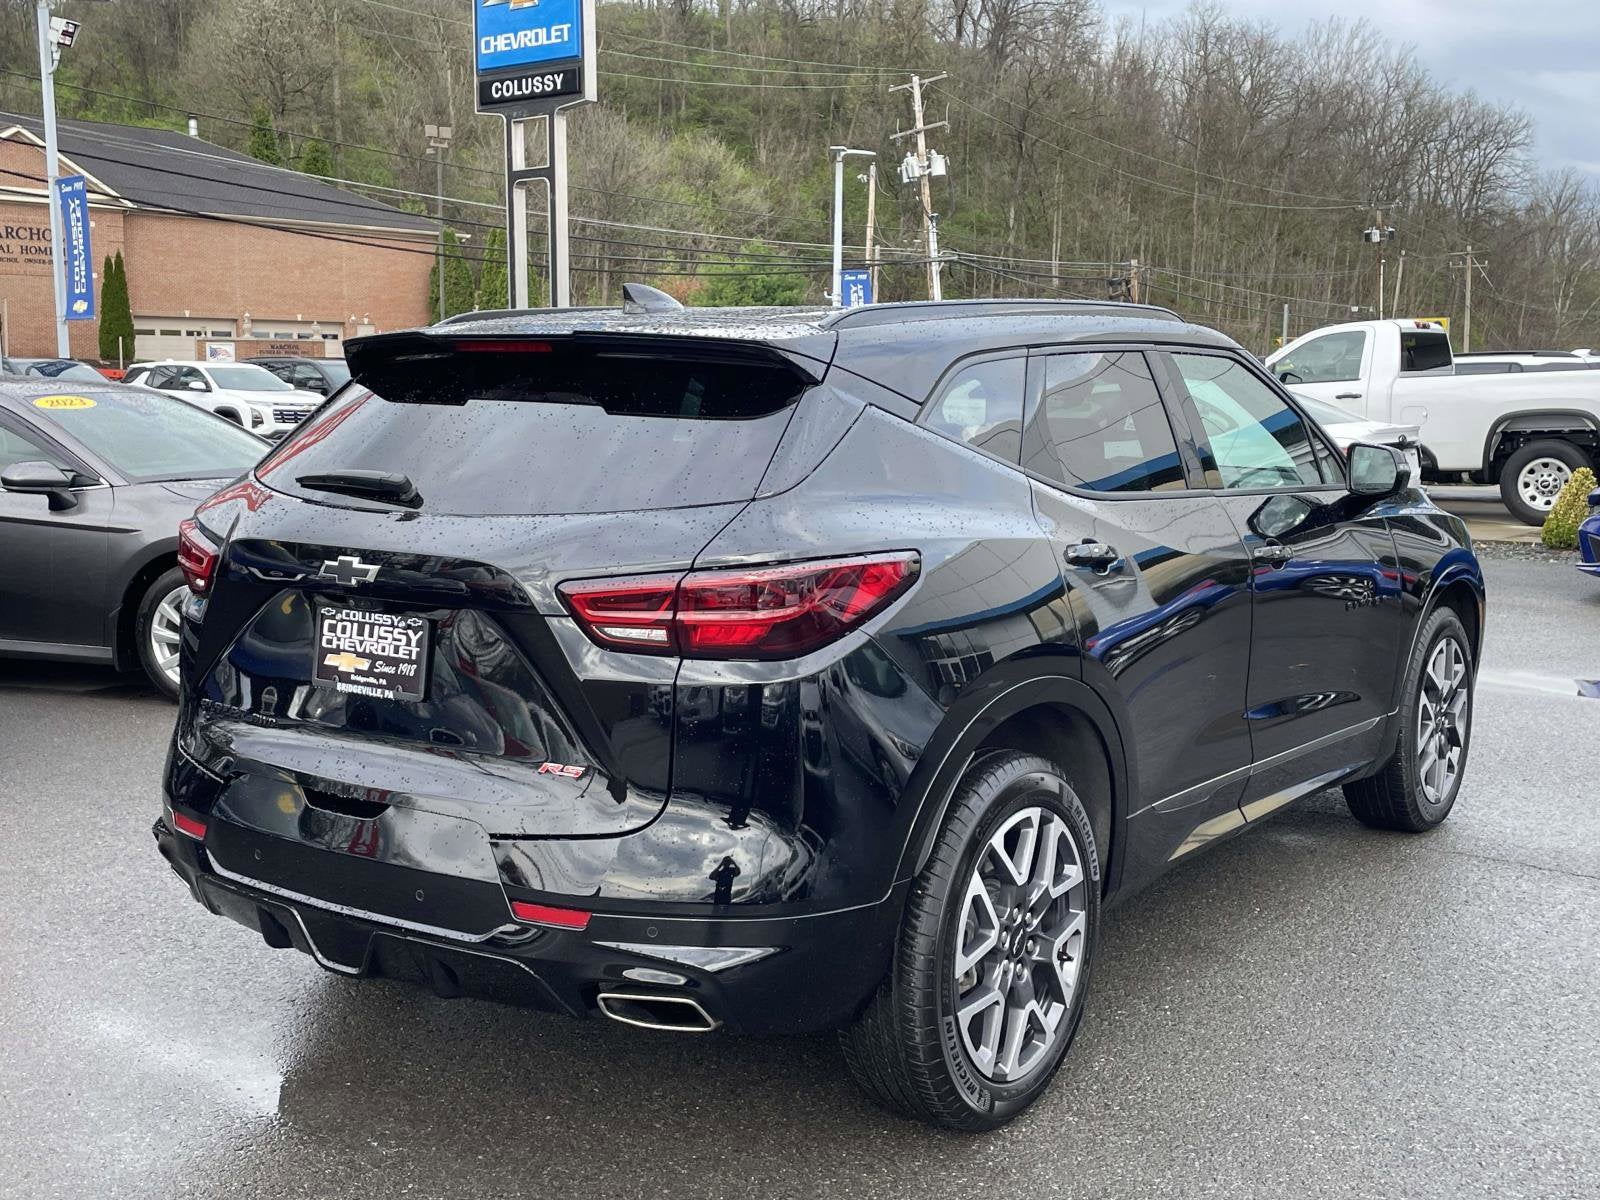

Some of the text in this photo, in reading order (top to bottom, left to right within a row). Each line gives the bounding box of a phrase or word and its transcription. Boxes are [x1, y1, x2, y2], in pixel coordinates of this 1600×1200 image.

[481, 24, 571, 54] CHEVROLET
[491, 73, 564, 98] COLUSSY
[68, 197, 81, 294] COLUSSY
[74, 197, 87, 293] CHEVROLET
[342, 609, 402, 627] COLUSSY
[322, 618, 424, 648] COLUSSY
[321, 635, 420, 660] CHEVROLET
[373, 660, 418, 677] Since 1918
[379, 677, 388, 686] PA
[384, 689, 395, 700] PA
[538, 762, 586, 778] RS
[1073, 804, 1099, 878] MICHELIN
[945, 1020, 978, 1096] MICHELIN
